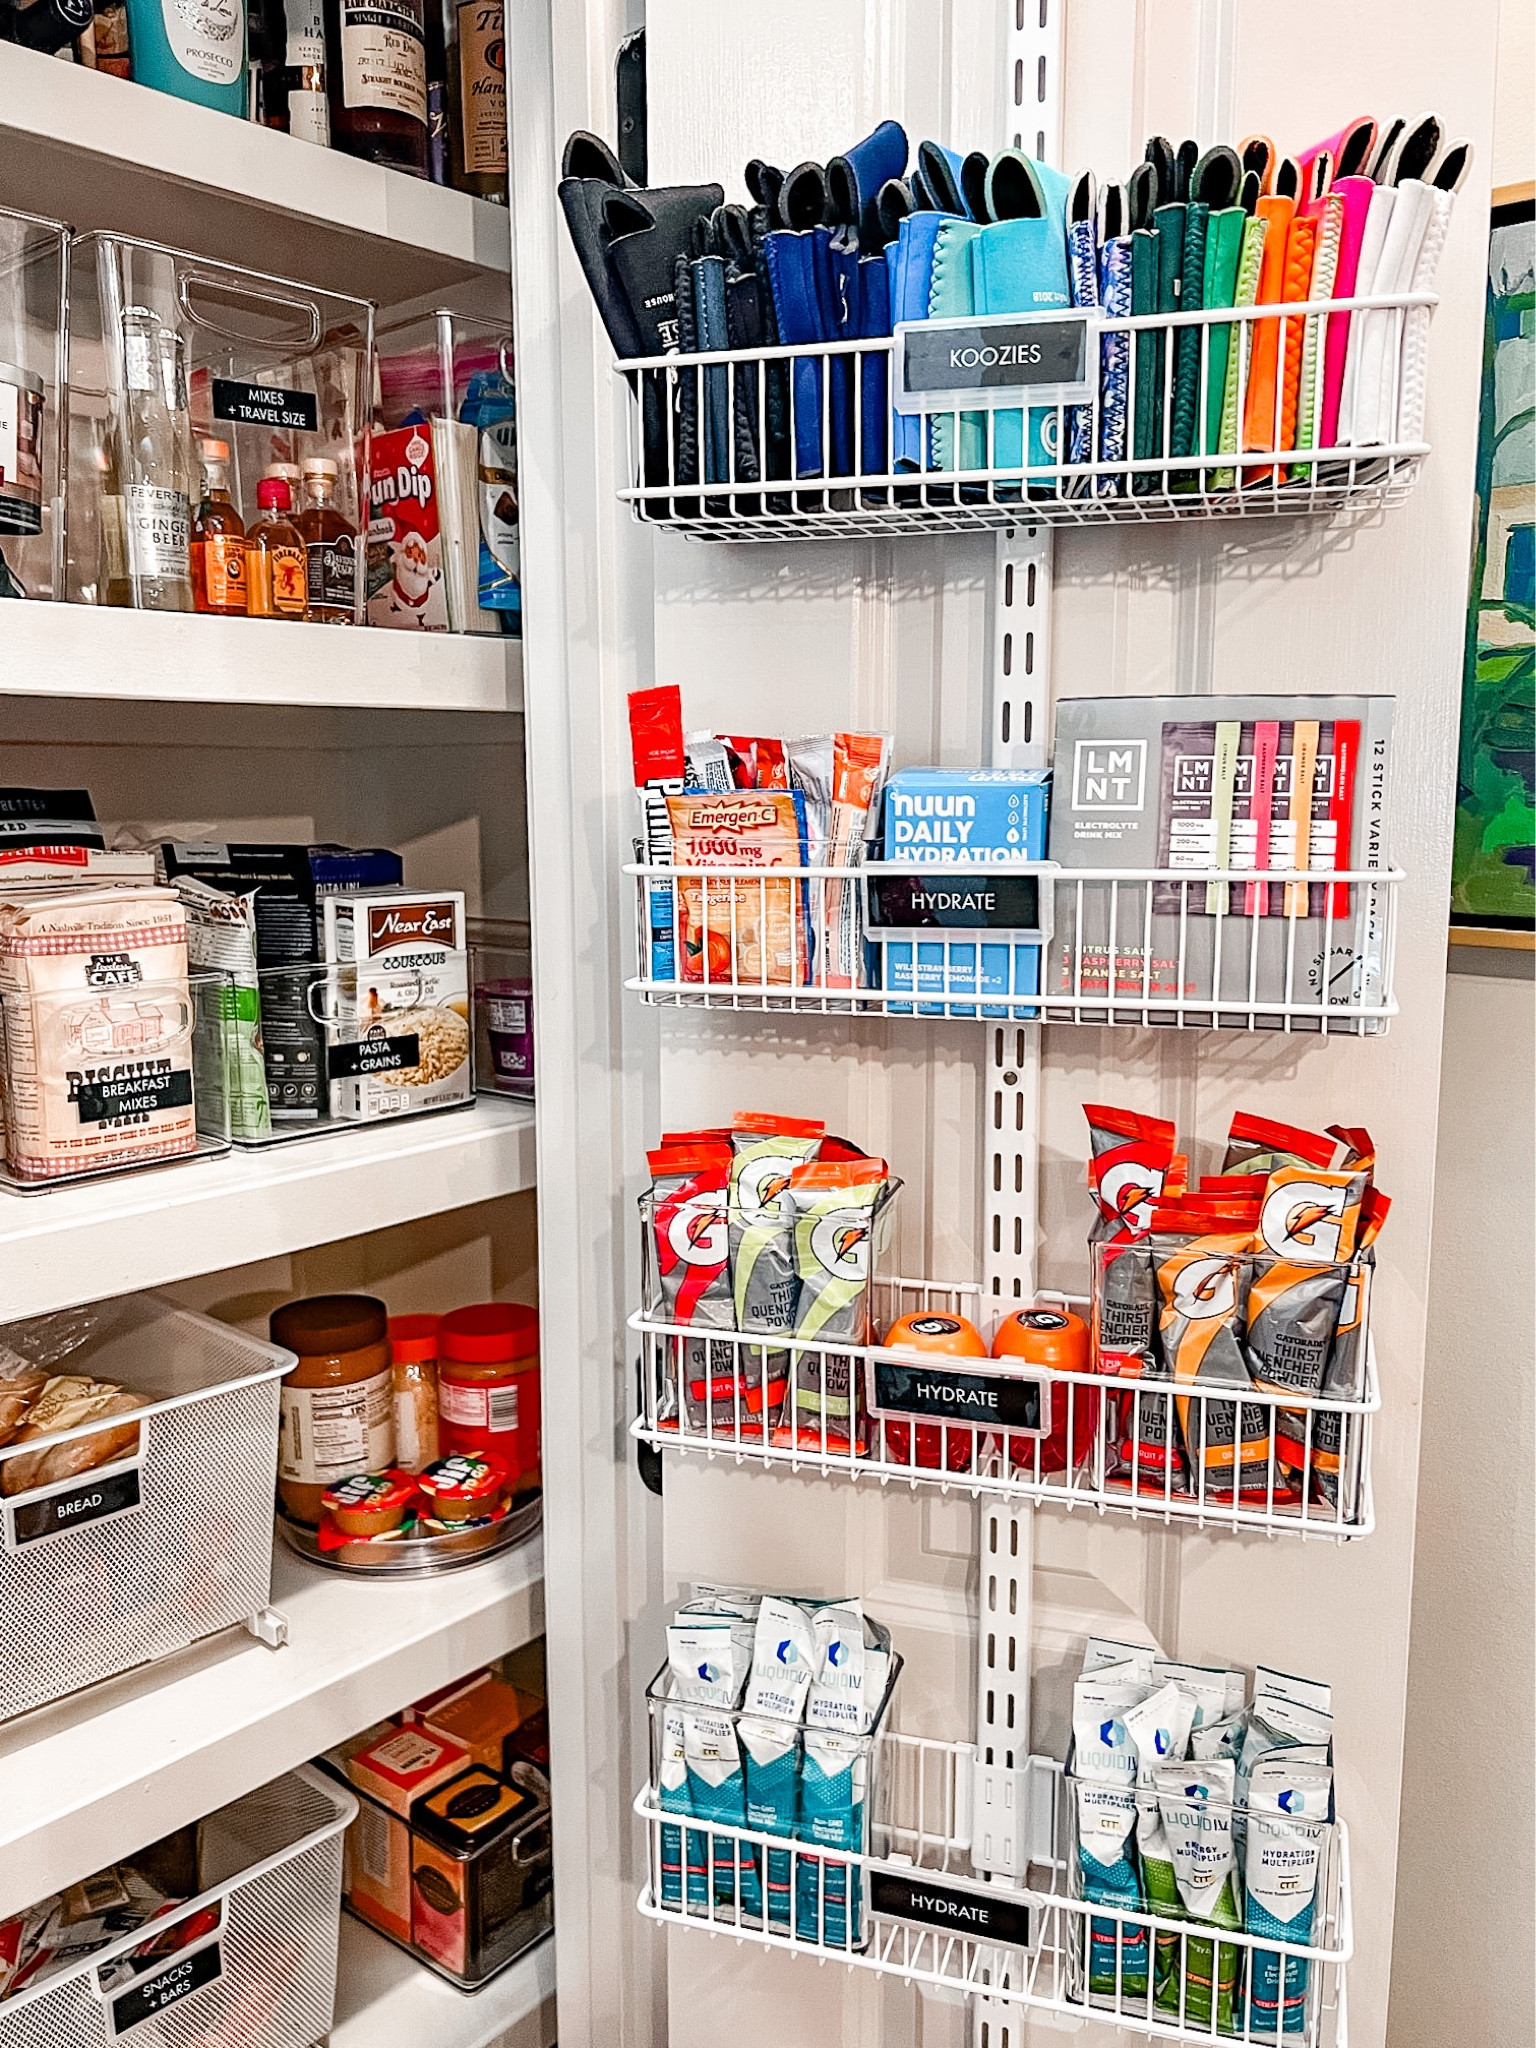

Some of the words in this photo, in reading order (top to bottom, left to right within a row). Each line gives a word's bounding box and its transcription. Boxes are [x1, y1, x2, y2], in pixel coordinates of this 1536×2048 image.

[186, 47, 233, 68] PROSECCO
[950, 344, 1042, 368] KOOZIES
[248, 388, 285, 407] MIXES
[228, 406, 237, 416] +
[239, 405, 280, 424] TRAVEL
[282, 411, 306, 427] SIZE
[397, 465, 431, 509] Dip
[152, 532, 186, 548] BEER
[1373, 739, 1385, 756] 12
[1370, 763, 1384, 811] STICK
[893, 793, 976, 818] nuun
[894, 820, 974, 844] DAILY
[1074, 821, 1139, 830] ELECTROLYTE
[1074, 831, 1103, 839] DRINK
[1104, 831, 1123, 839] MIX
[686, 836, 738, 858] 1,000
[739, 847, 763, 858] mg
[911, 892, 996, 911] HYDRATE
[86, 919, 125, 932] Tradition
[125, 916, 151, 928] Since
[152, 914, 173, 925] 1951
[372, 911, 422, 939] Near
[421, 910, 453, 936] East
[1062, 944, 1070, 953] 3
[382, 952, 447, 970] COUSCOUS
[1062, 955, 1070, 965] 3
[90, 971, 140, 986] CAFE
[1061, 967, 1069, 976] 3
[358, 1041, 391, 1056] PASTA
[359, 1054, 402, 1072] GRAINS
[102, 1075, 172, 1099] BREAKFAST
[118, 1095, 158, 1113] MIXES
[1105, 1308, 1150, 1324] THIRST
[1273, 1342, 1323, 1362] THIRST
[1259, 1363, 1318, 1388] POWDER
[916, 1382, 999, 1409] HYDRATE
[459, 1478, 479, 1492] TO
[470, 1464, 490, 1479] GO
[57, 1493, 102, 1519] BREAD
[812, 1707, 858, 1721] MULTIPLIER
[813, 1698, 858, 1713] HYDRATION
[1084, 1791, 1136, 1804] HYDRATION
[1261, 1856, 1316, 1867] MULTIPLIER
[1262, 1849, 1316, 1860] HYDRATION
[911, 1892, 990, 1925] HYDRATE
[142, 1960, 194, 1998] SNACKS
[160, 1978, 192, 2006] BARS
